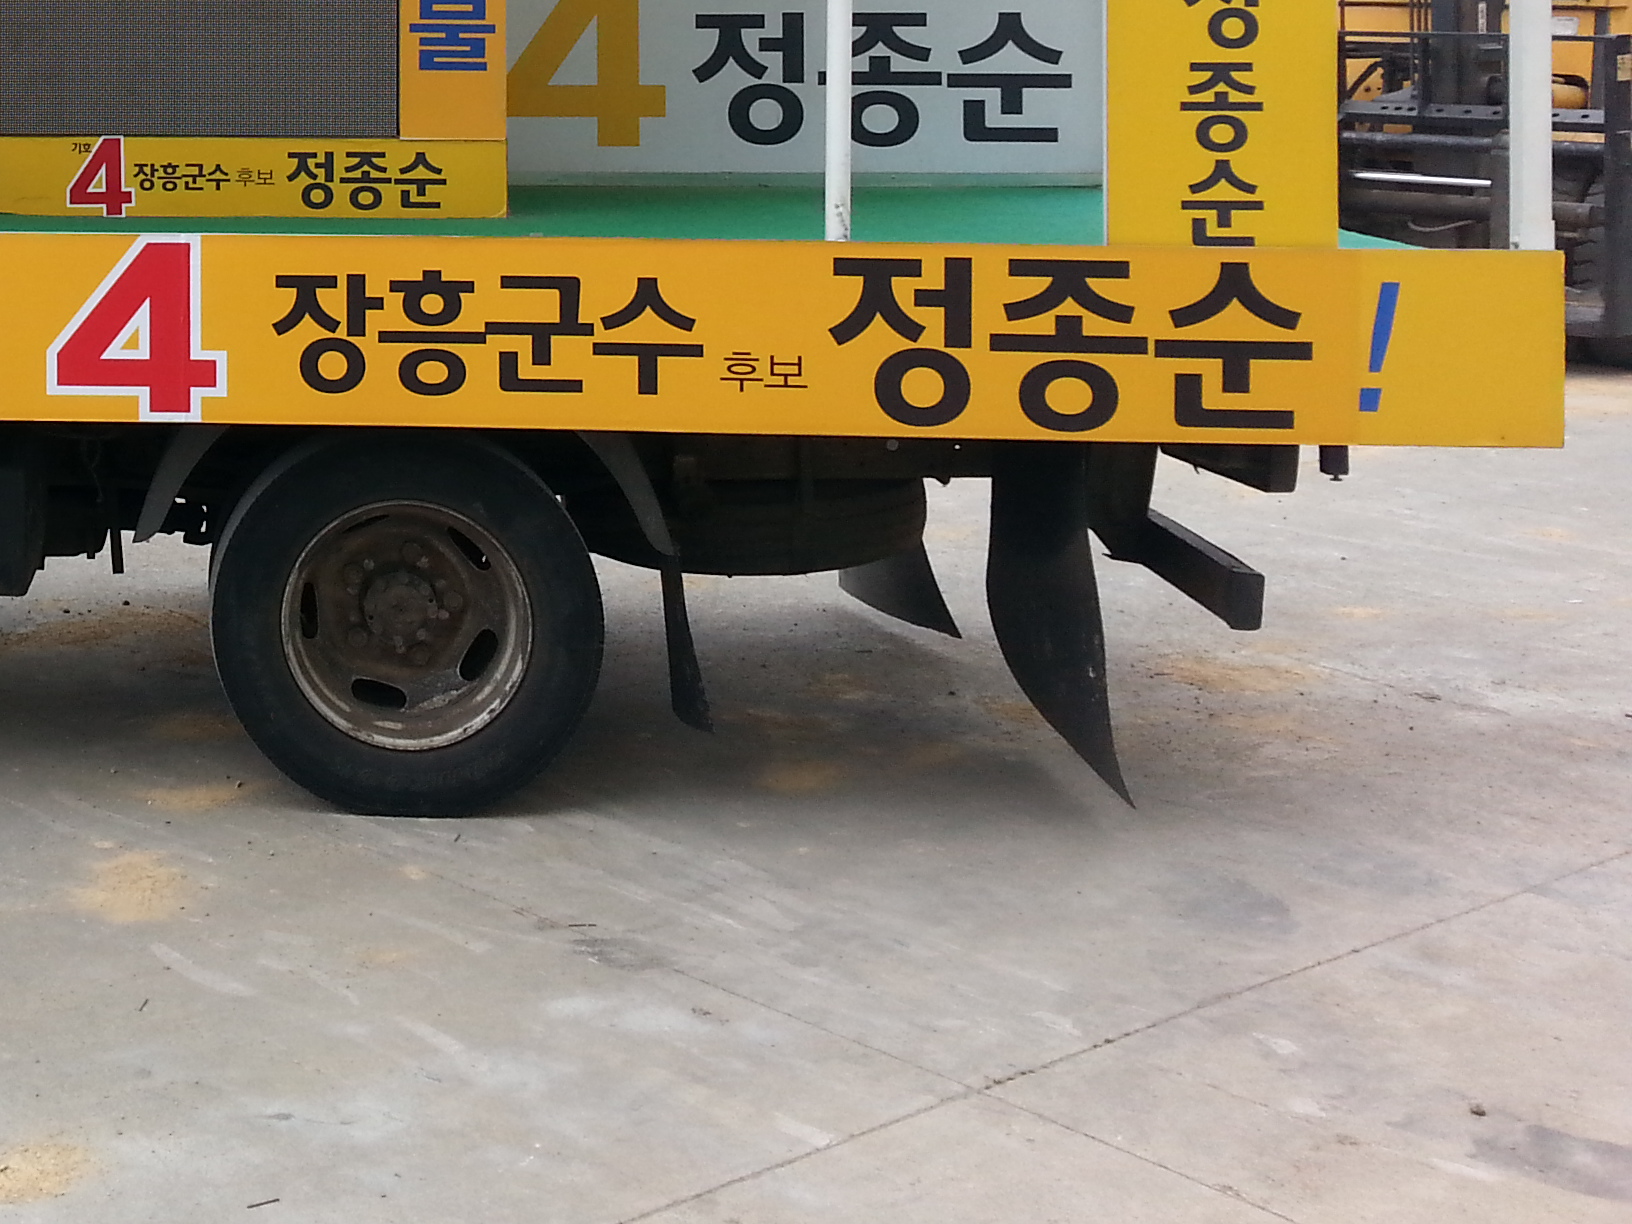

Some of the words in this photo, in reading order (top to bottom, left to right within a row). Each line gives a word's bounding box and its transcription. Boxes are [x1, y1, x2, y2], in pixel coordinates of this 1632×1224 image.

[692, 12, 1073, 147] 정종순
[66, 135, 135, 217] 4
[71, 142, 93, 154] 기호
[133, 162, 231, 191] 장흥군수
[235, 168, 275, 187] 후보
[286, 150, 449, 210] 정종순
[46, 234, 227, 421] 4
[271, 269, 704, 397] 장흥군수
[719, 351, 809, 393] 후보
